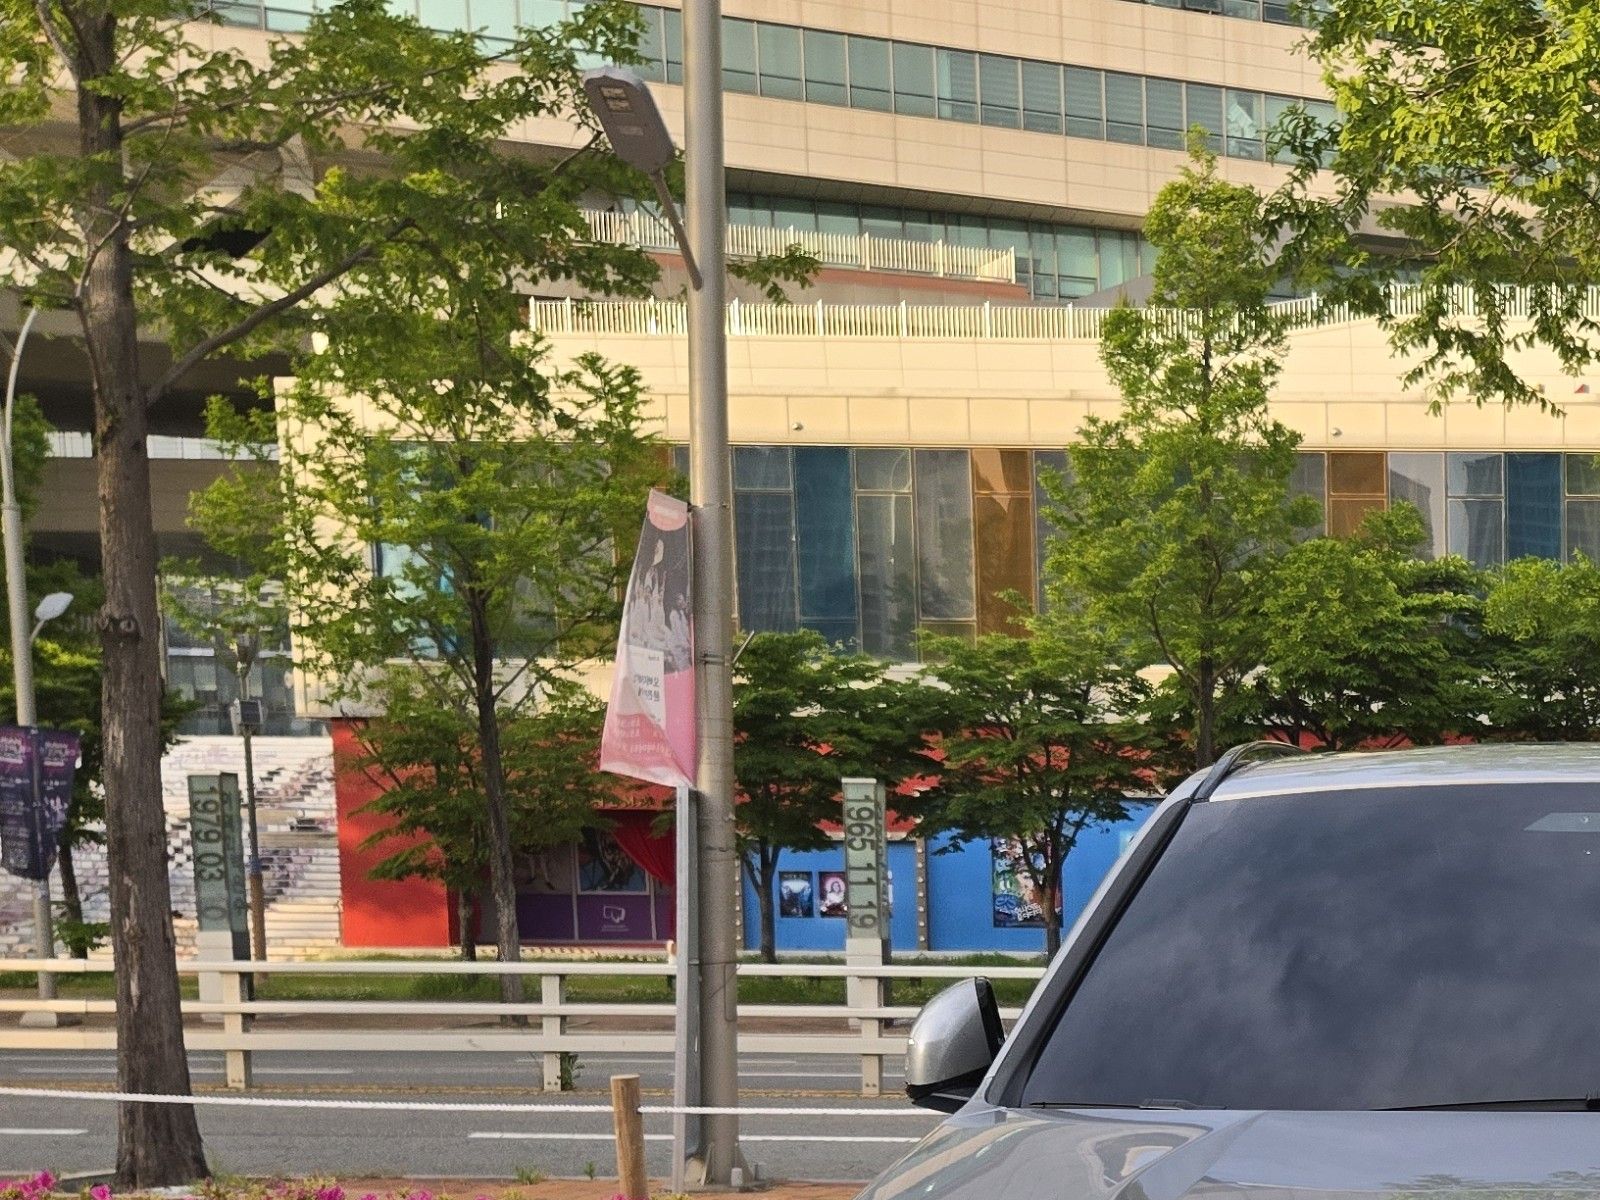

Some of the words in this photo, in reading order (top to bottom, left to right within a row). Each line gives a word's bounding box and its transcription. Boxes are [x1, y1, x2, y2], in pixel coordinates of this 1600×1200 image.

[191, 786, 221, 844] 1979
[846, 794, 877, 852] 1965
[848, 862, 877, 886] 11
[850, 900, 878, 929] 19
